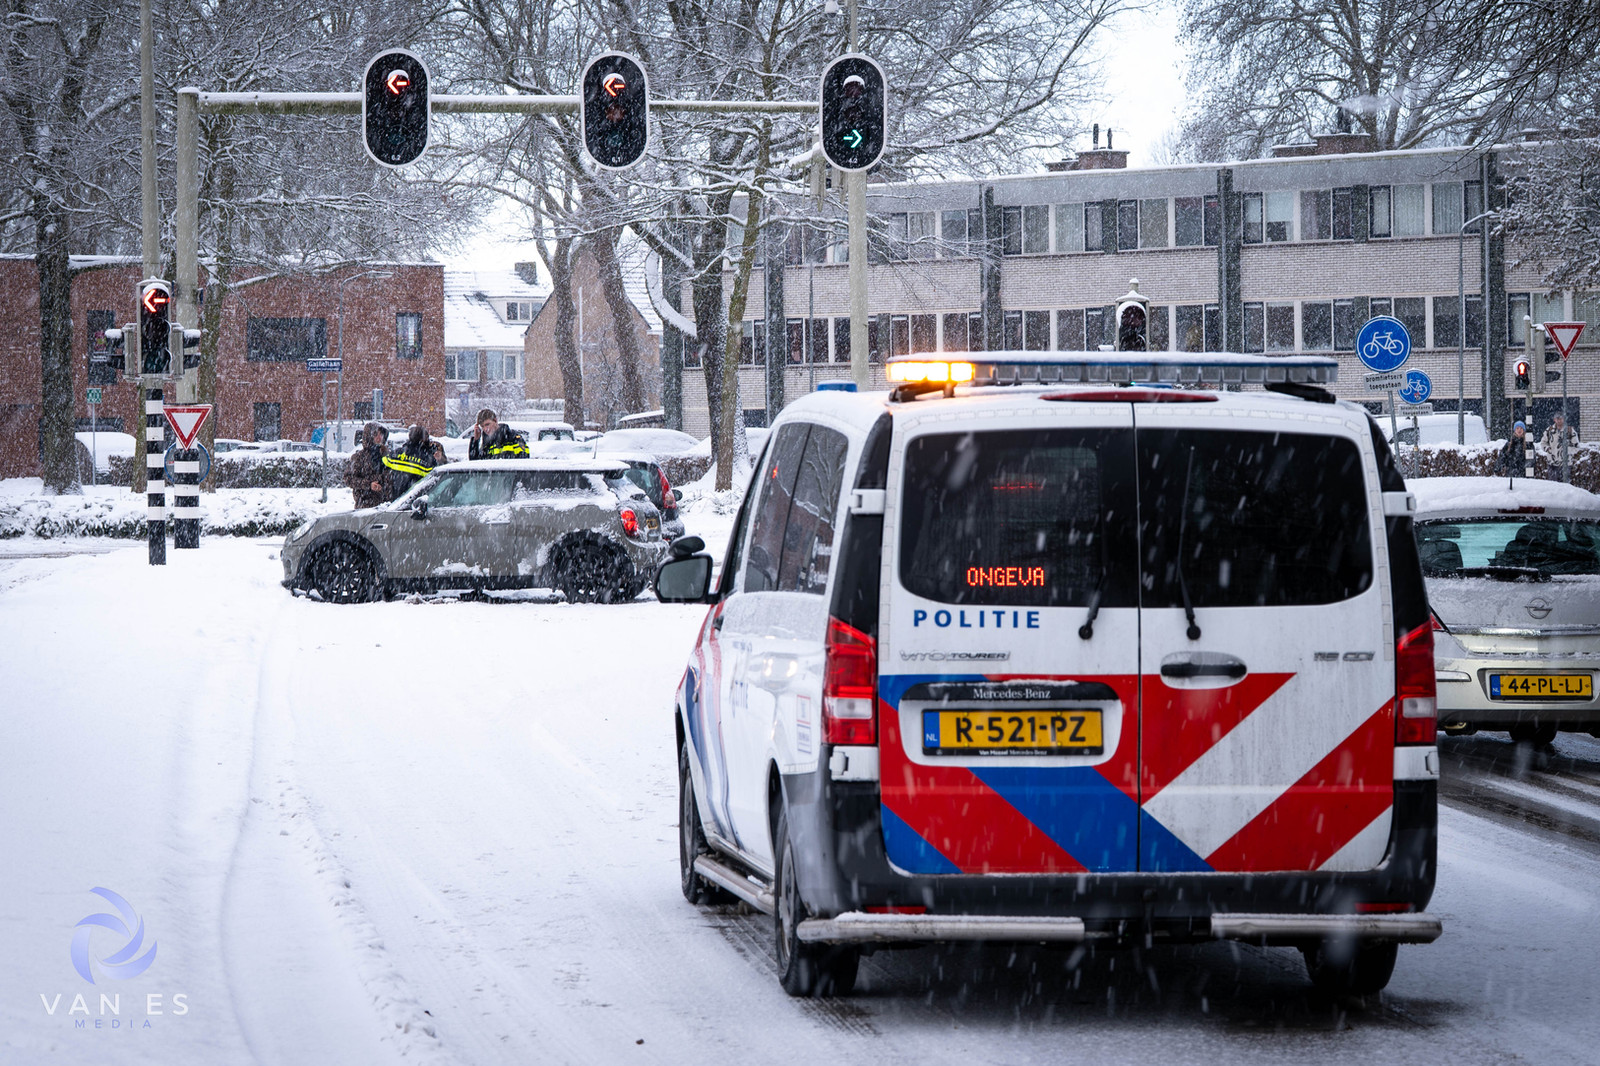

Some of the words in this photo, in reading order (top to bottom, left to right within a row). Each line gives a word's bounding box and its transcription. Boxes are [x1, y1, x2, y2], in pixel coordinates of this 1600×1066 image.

[966, 566, 1045, 587] ONGEVA
[913, 609, 1040, 629] POLITIE
[950, 651, 1007, 660] TOURER
[973, 688, 1051, 699] Mercedes-Benz
[1508, 678, 1583, 693] 44-PL-LJ
[925, 734, 938, 742] NL
[955, 716, 1086, 743] R-521-PZ
